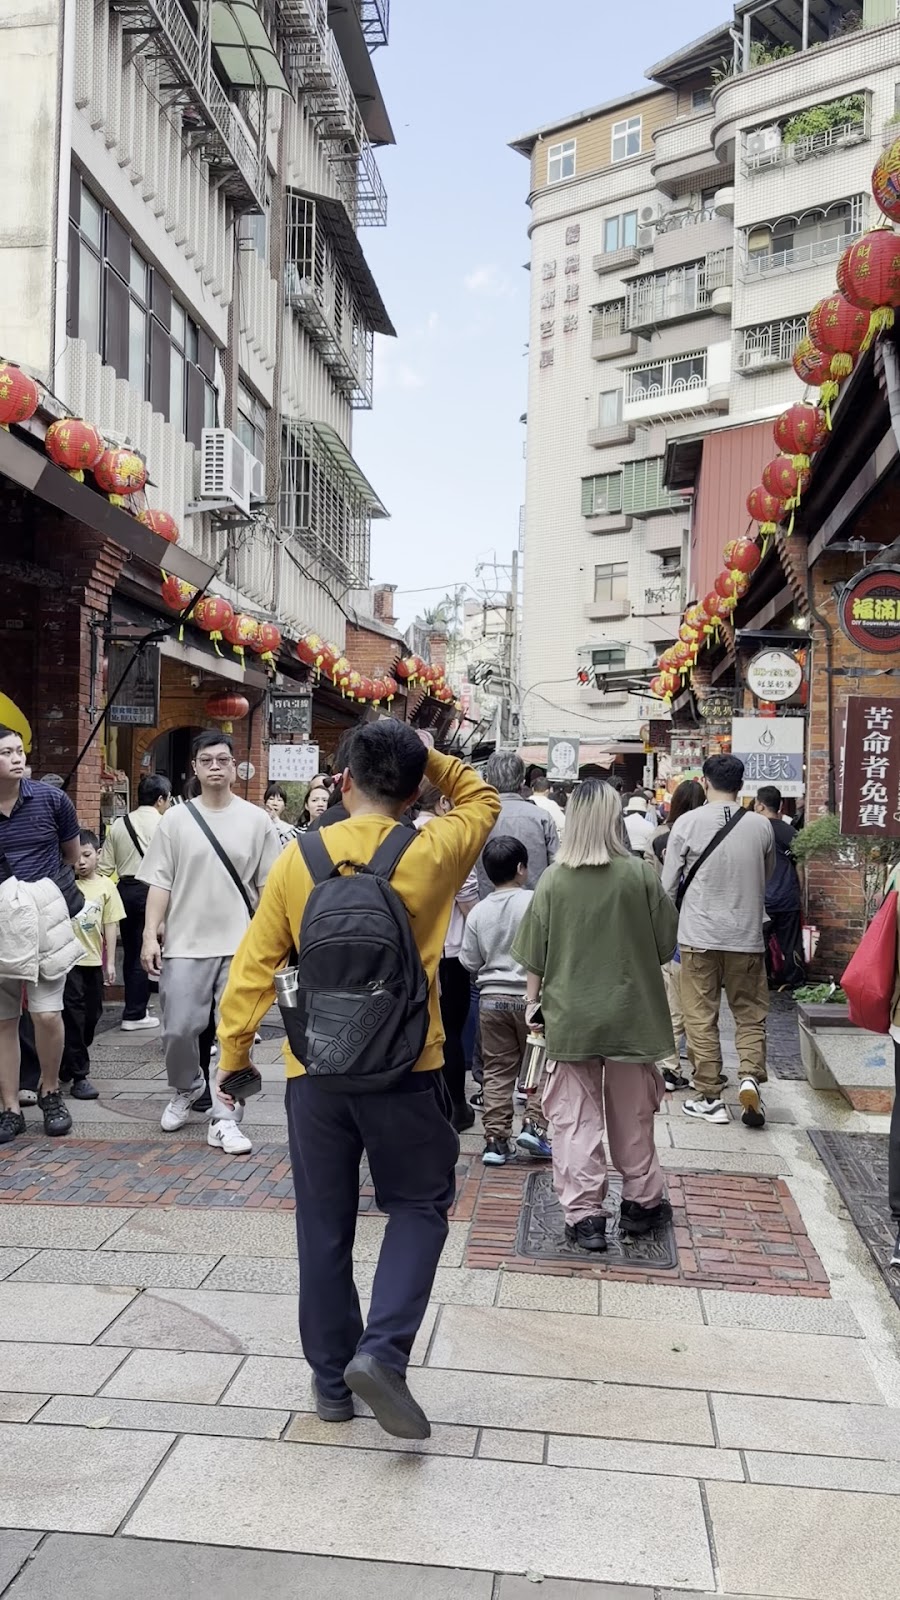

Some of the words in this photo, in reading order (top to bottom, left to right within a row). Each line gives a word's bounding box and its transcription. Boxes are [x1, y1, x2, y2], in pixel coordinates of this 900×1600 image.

[856, 244, 872, 280] 財源
[852, 597, 900, 620] 福滿
[744, 753, 789, 780] 銀家
[858, 706, 893, 828] 苦命者免費
[316, 996, 392, 1074] adidas
